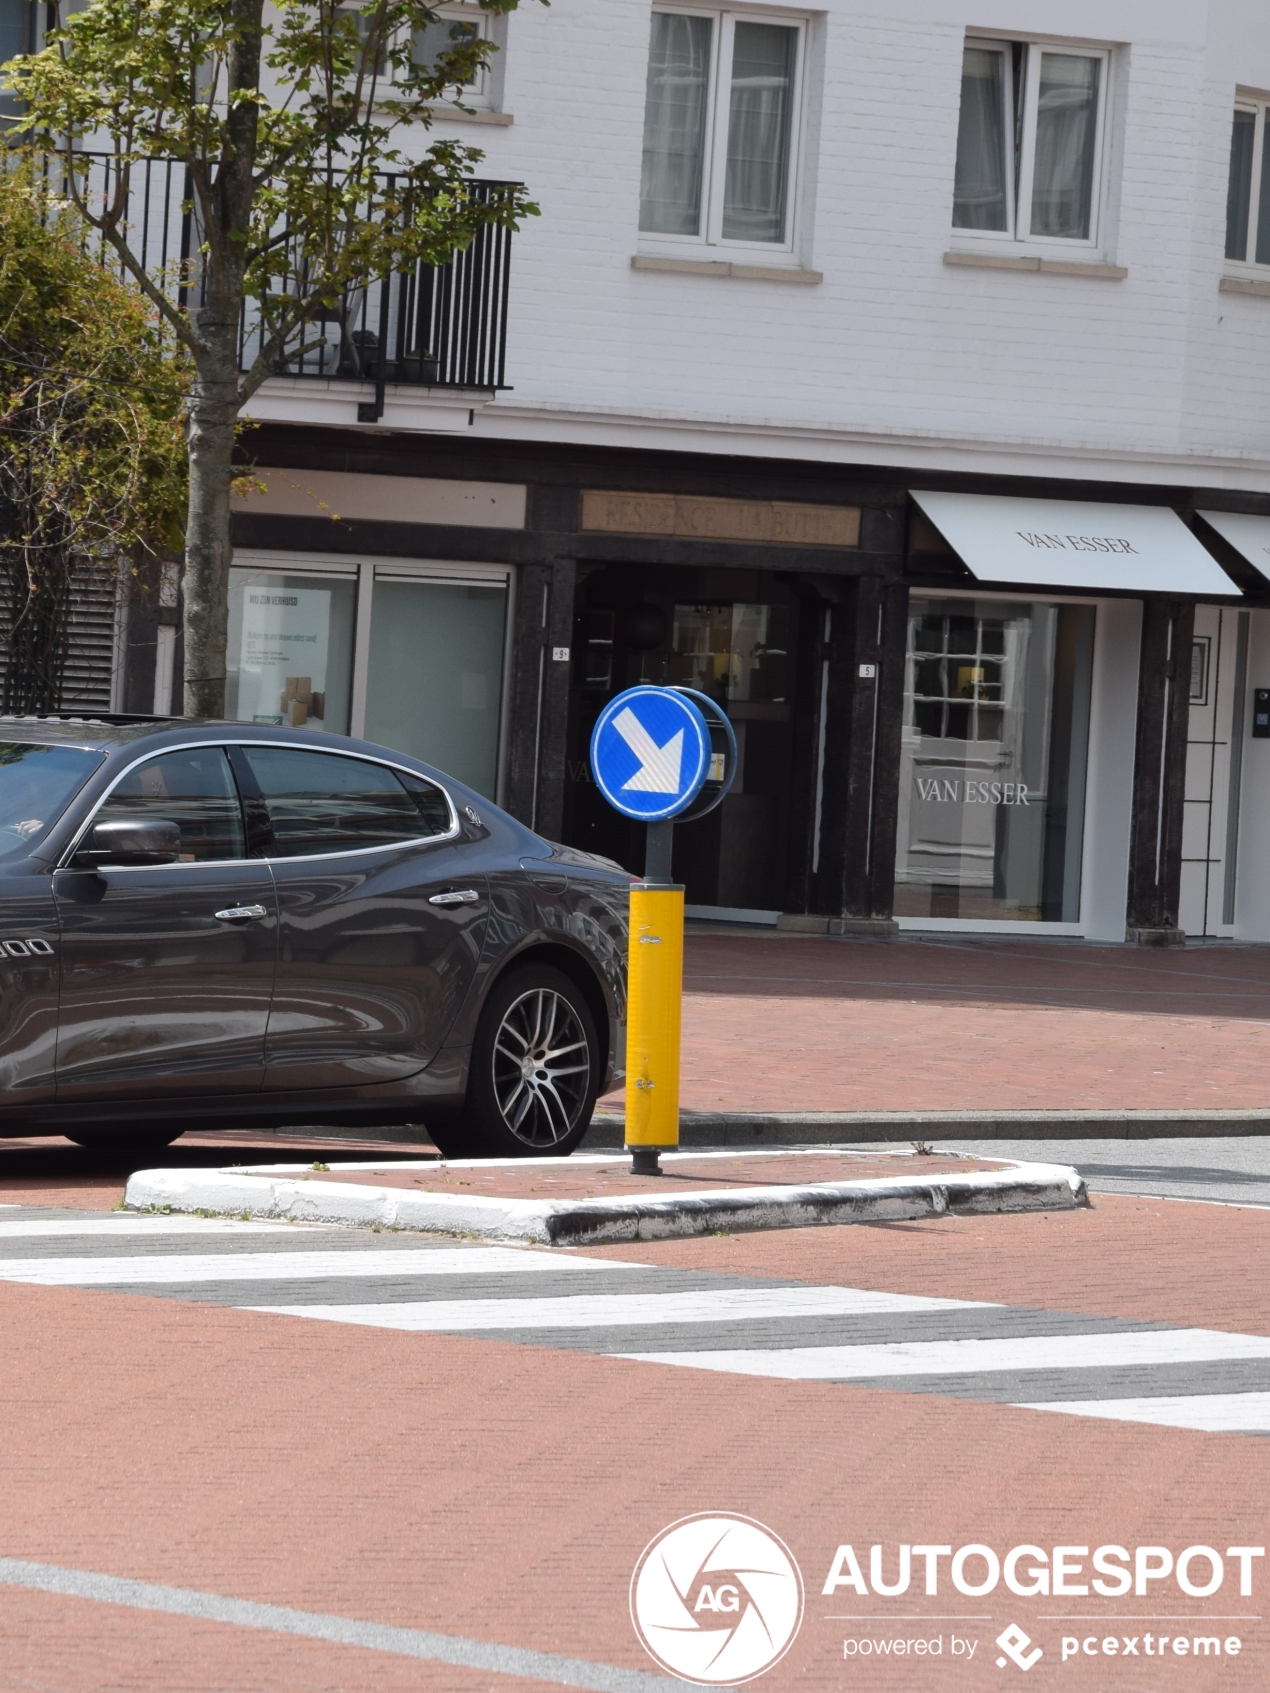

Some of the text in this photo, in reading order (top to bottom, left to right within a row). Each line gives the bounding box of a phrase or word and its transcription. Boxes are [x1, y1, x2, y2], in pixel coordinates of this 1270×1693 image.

[1016, 531, 1140, 555] VAN ESSER
[566, 759, 595, 783] VA
[916, 778, 1030, 806] VAN ESSER
